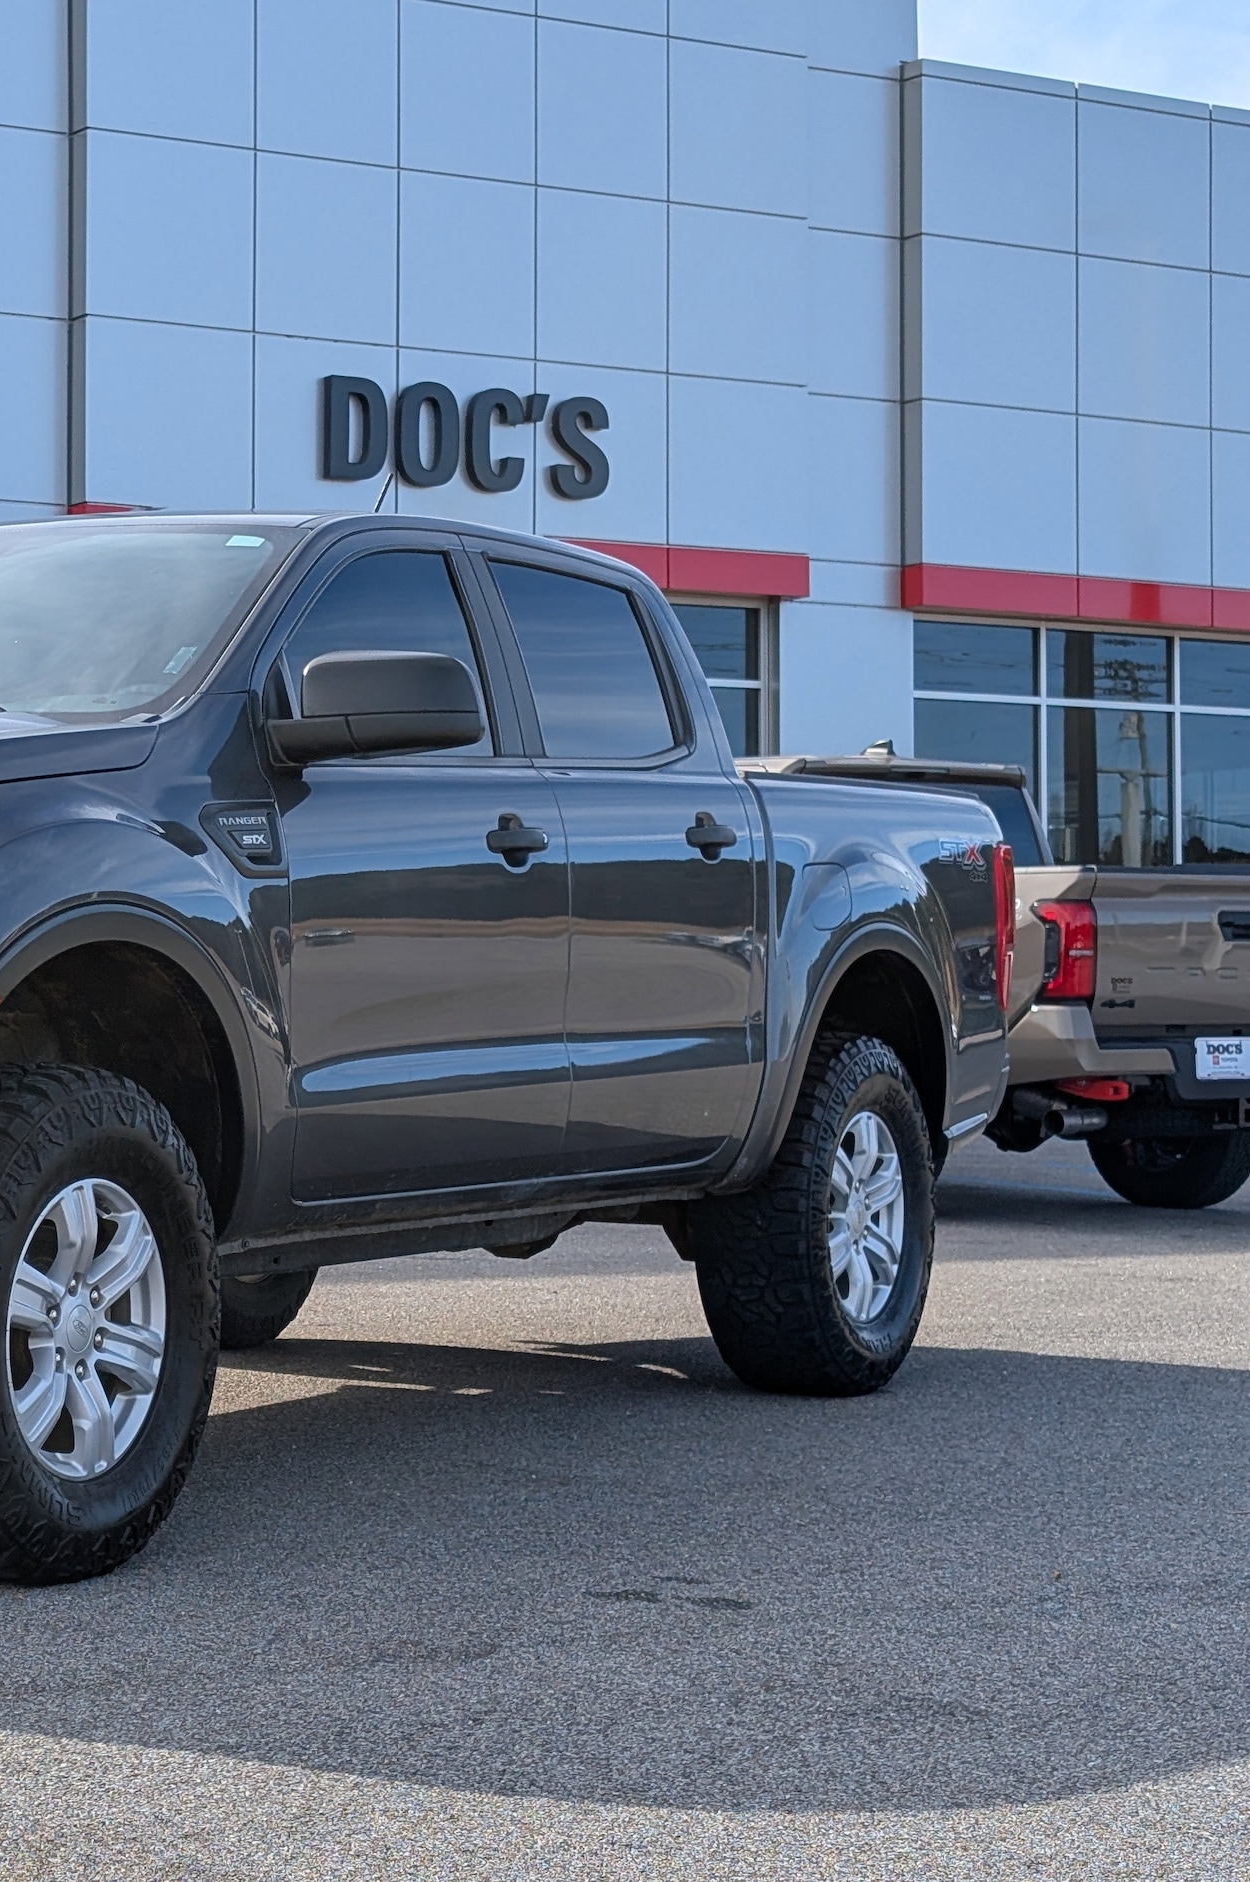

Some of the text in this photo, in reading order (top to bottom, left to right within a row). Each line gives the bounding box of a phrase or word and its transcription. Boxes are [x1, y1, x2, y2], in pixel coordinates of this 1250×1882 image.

[323, 374, 610, 500] DOC'S
[218, 816, 267, 826] RANGER
[242, 834, 268, 845] STX
[939, 839, 986, 871] STX
